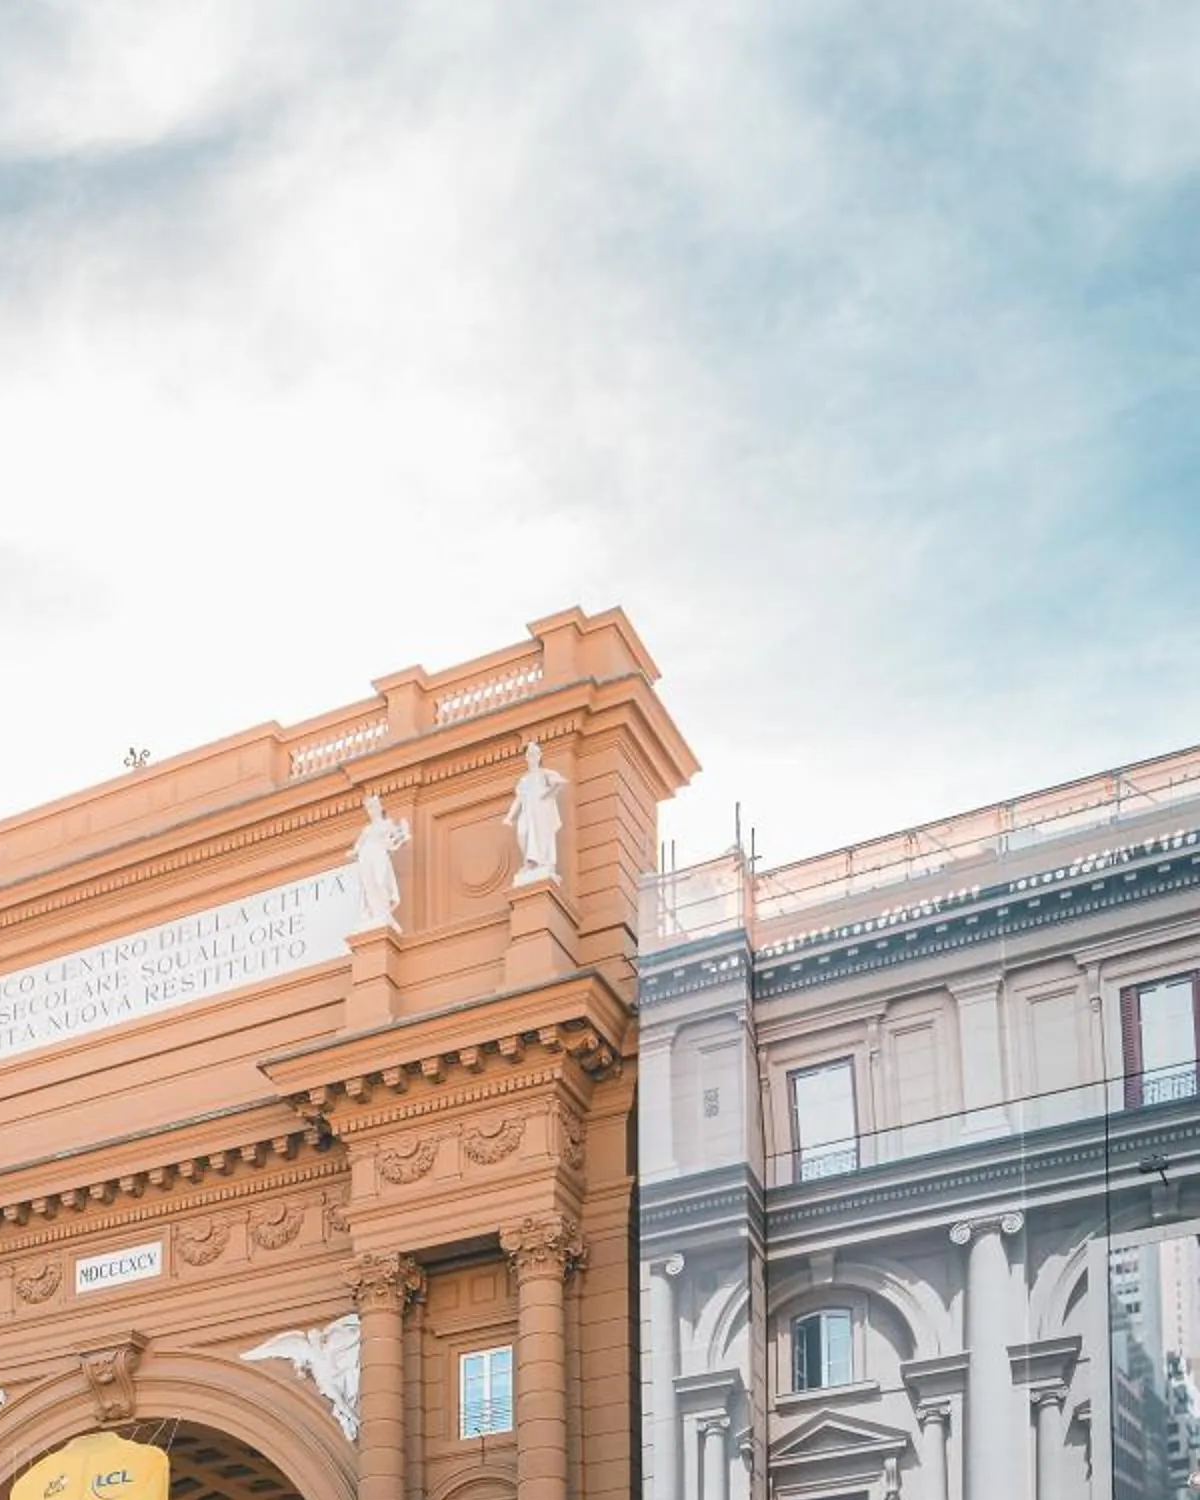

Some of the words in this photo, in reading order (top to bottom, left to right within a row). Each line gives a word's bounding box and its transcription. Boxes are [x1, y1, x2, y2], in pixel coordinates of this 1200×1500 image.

[45, 938, 148, 983] CENTRO
[159, 908, 250, 950] DELLA
[140, 913, 306, 979] SQUALLORE
[49, 994, 132, 1031] NUOVA
[143, 940, 307, 1004] RESTITUITO
[96, 1470, 135, 1487] LCL
